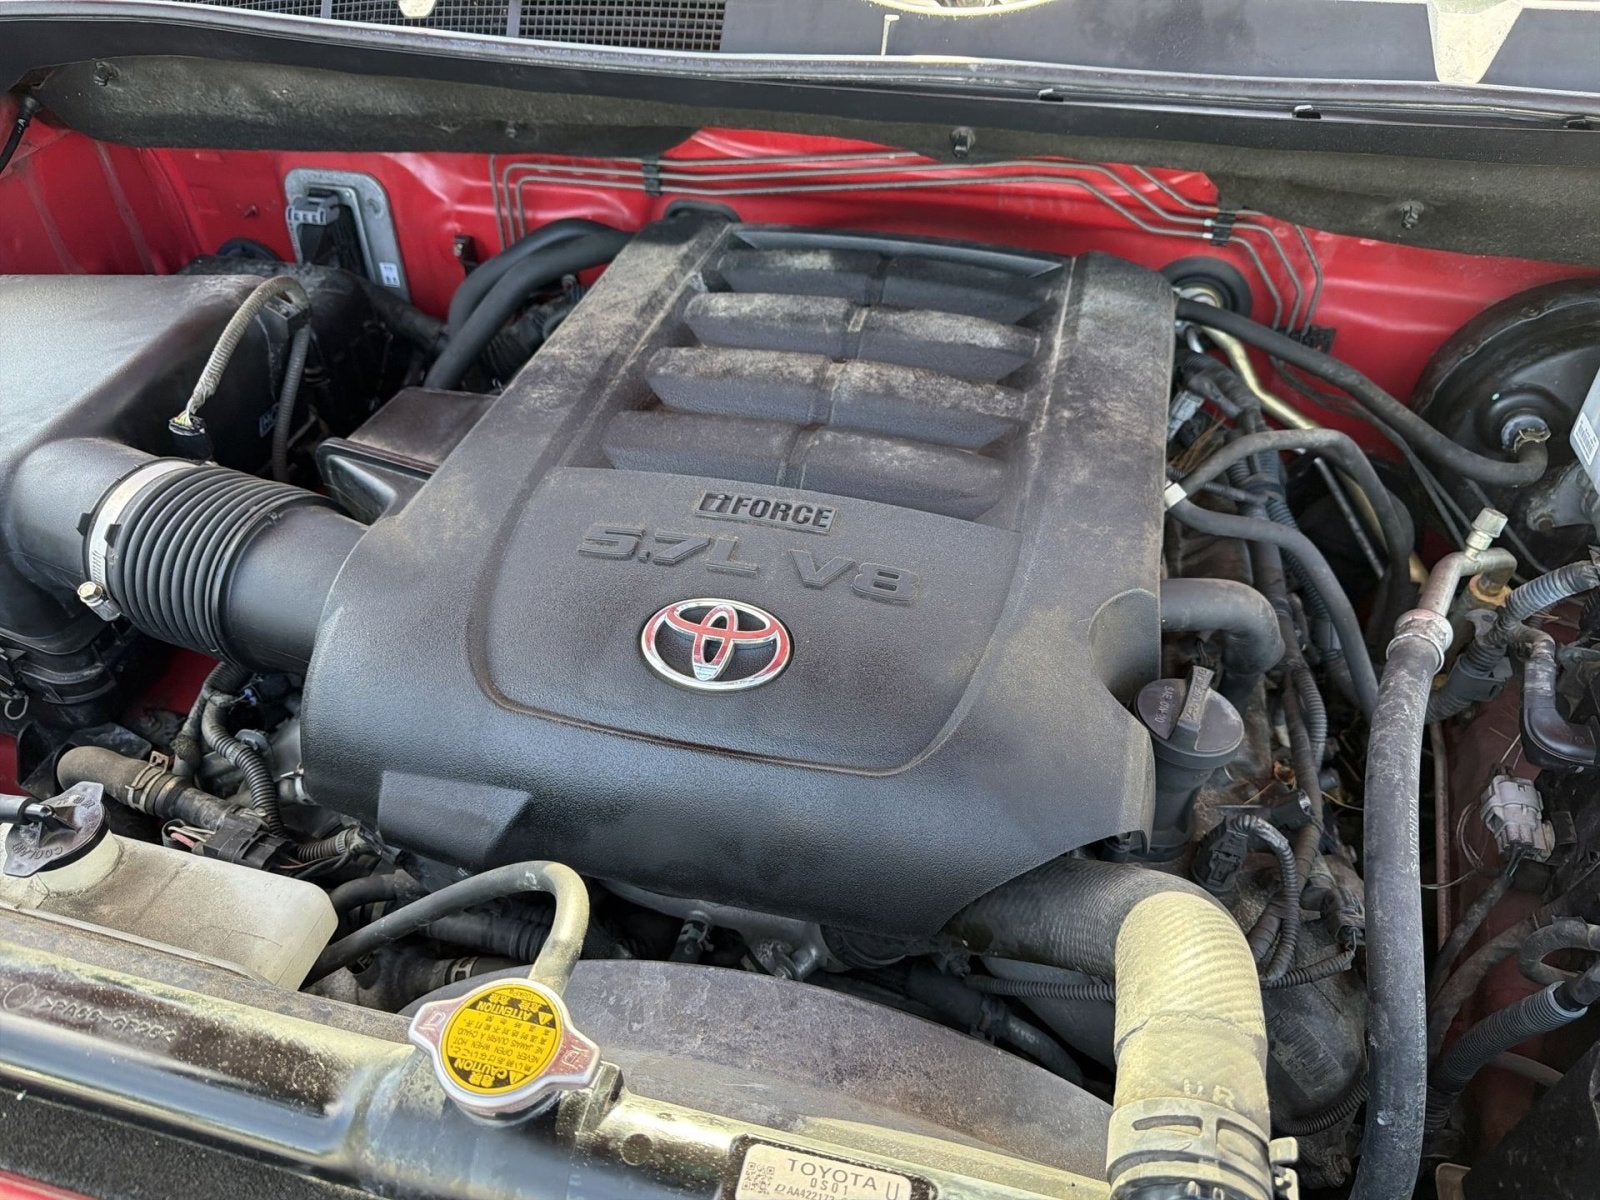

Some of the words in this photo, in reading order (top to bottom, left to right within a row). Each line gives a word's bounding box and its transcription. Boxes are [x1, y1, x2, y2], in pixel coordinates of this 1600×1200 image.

[577, 523, 760, 579] 5.7L
[789, 549, 921, 605] V8
[475, 1001, 533, 1022] ATTENTION
[494, 1046, 514, 1057] OPEN
[516, 1052, 539, 1064] NEVER
[454, 1058, 508, 1080] CAUTION
[788, 1158, 877, 1191] TOYOTA
